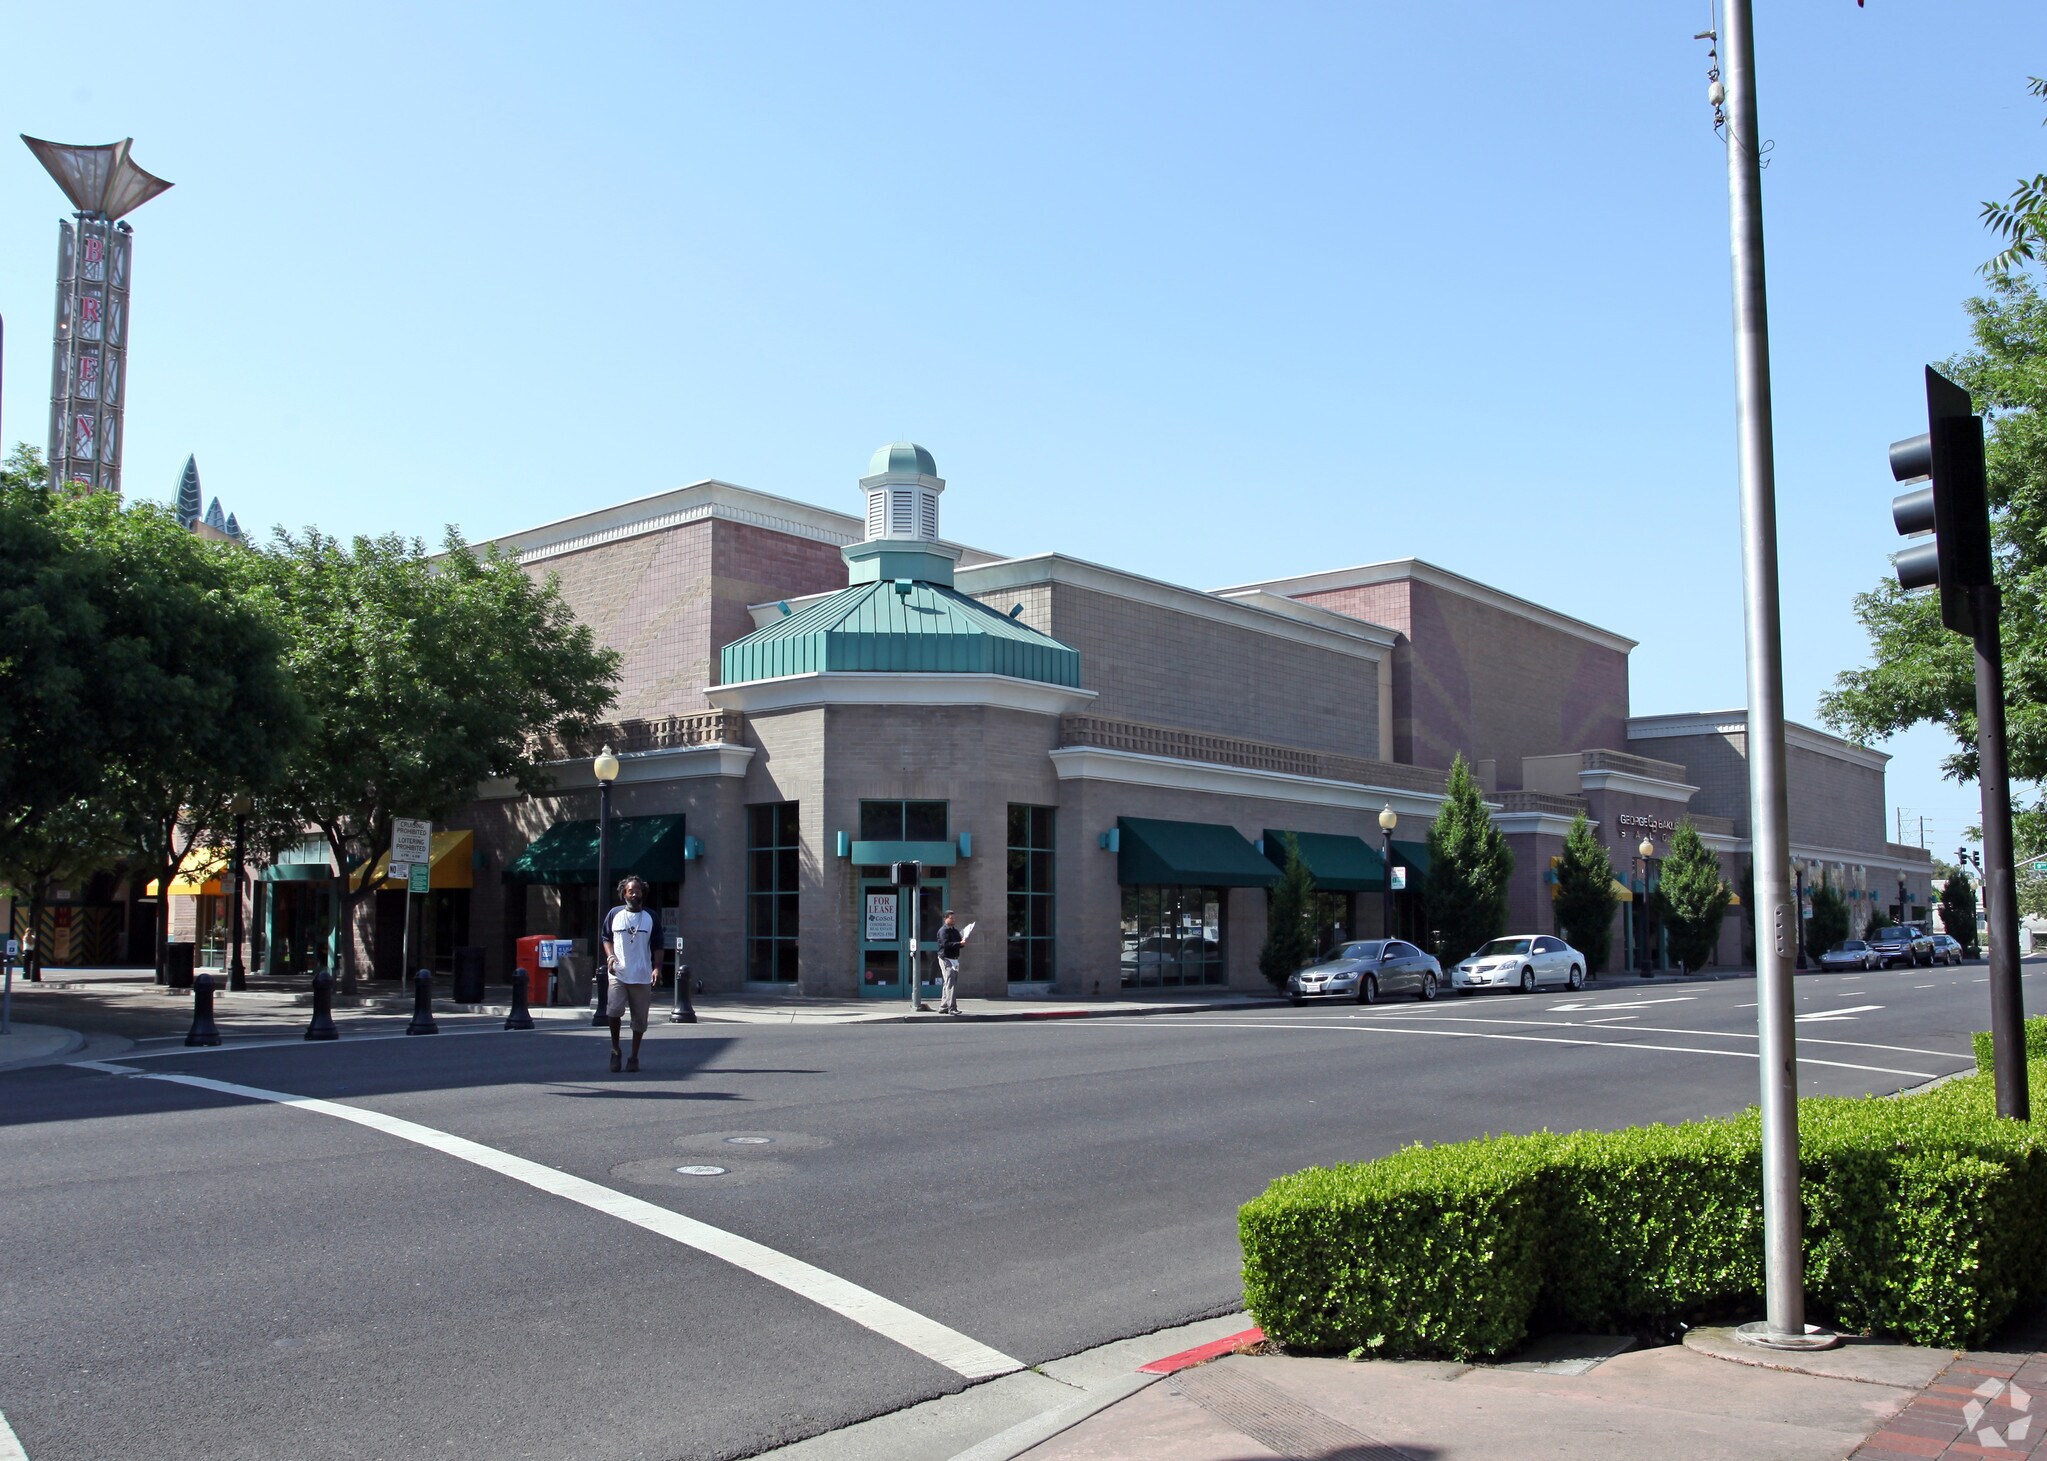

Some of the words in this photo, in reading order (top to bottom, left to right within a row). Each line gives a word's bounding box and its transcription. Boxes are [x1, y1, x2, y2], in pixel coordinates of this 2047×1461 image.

[1620, 814, 1648, 827] GEORGE
[396, 828, 426, 836] PROHIBITED
[396, 844, 426, 852] PROHIBITED
[390, 866, 396, 874] NO
[874, 896, 890, 905] FOR
[869, 905, 894, 913] LEASE
